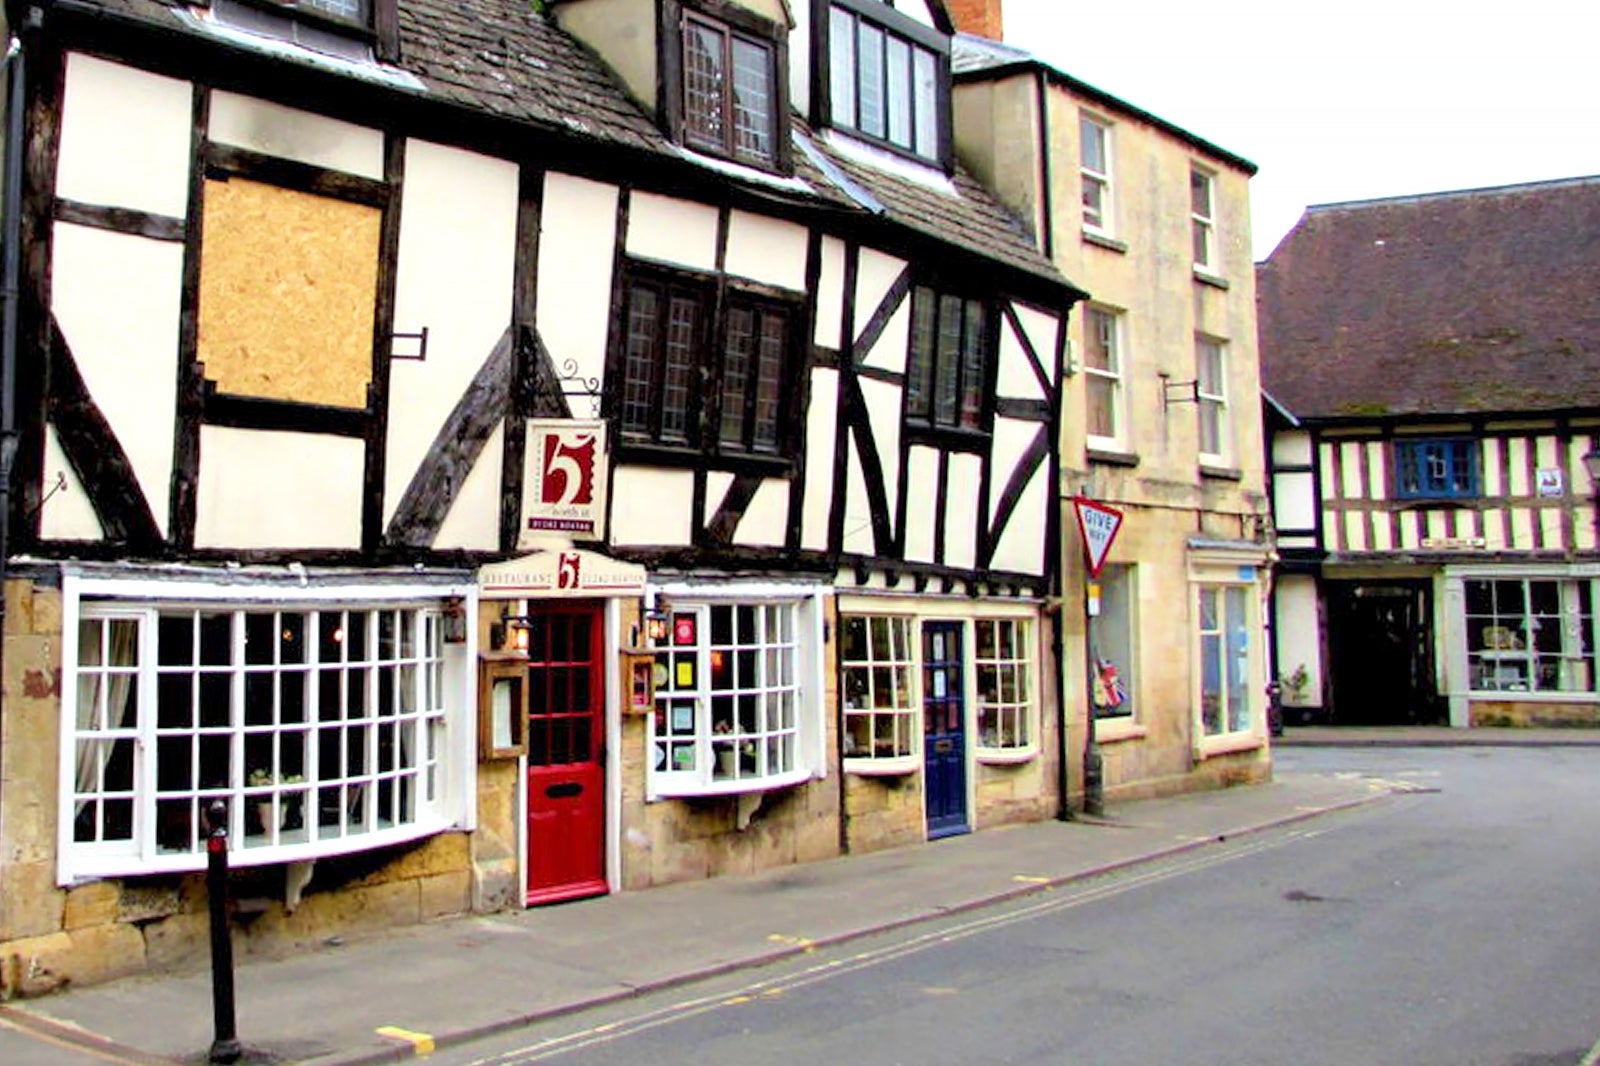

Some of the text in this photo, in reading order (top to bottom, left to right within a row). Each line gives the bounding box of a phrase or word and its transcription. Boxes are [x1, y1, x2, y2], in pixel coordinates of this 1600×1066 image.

[543, 433, 597, 505] 5
[1085, 509, 1111, 530] GIVE
[1088, 528, 1106, 542] WAY
[485, 573, 552, 585] RESTAURANT
[559, 553, 580, 588] 5
